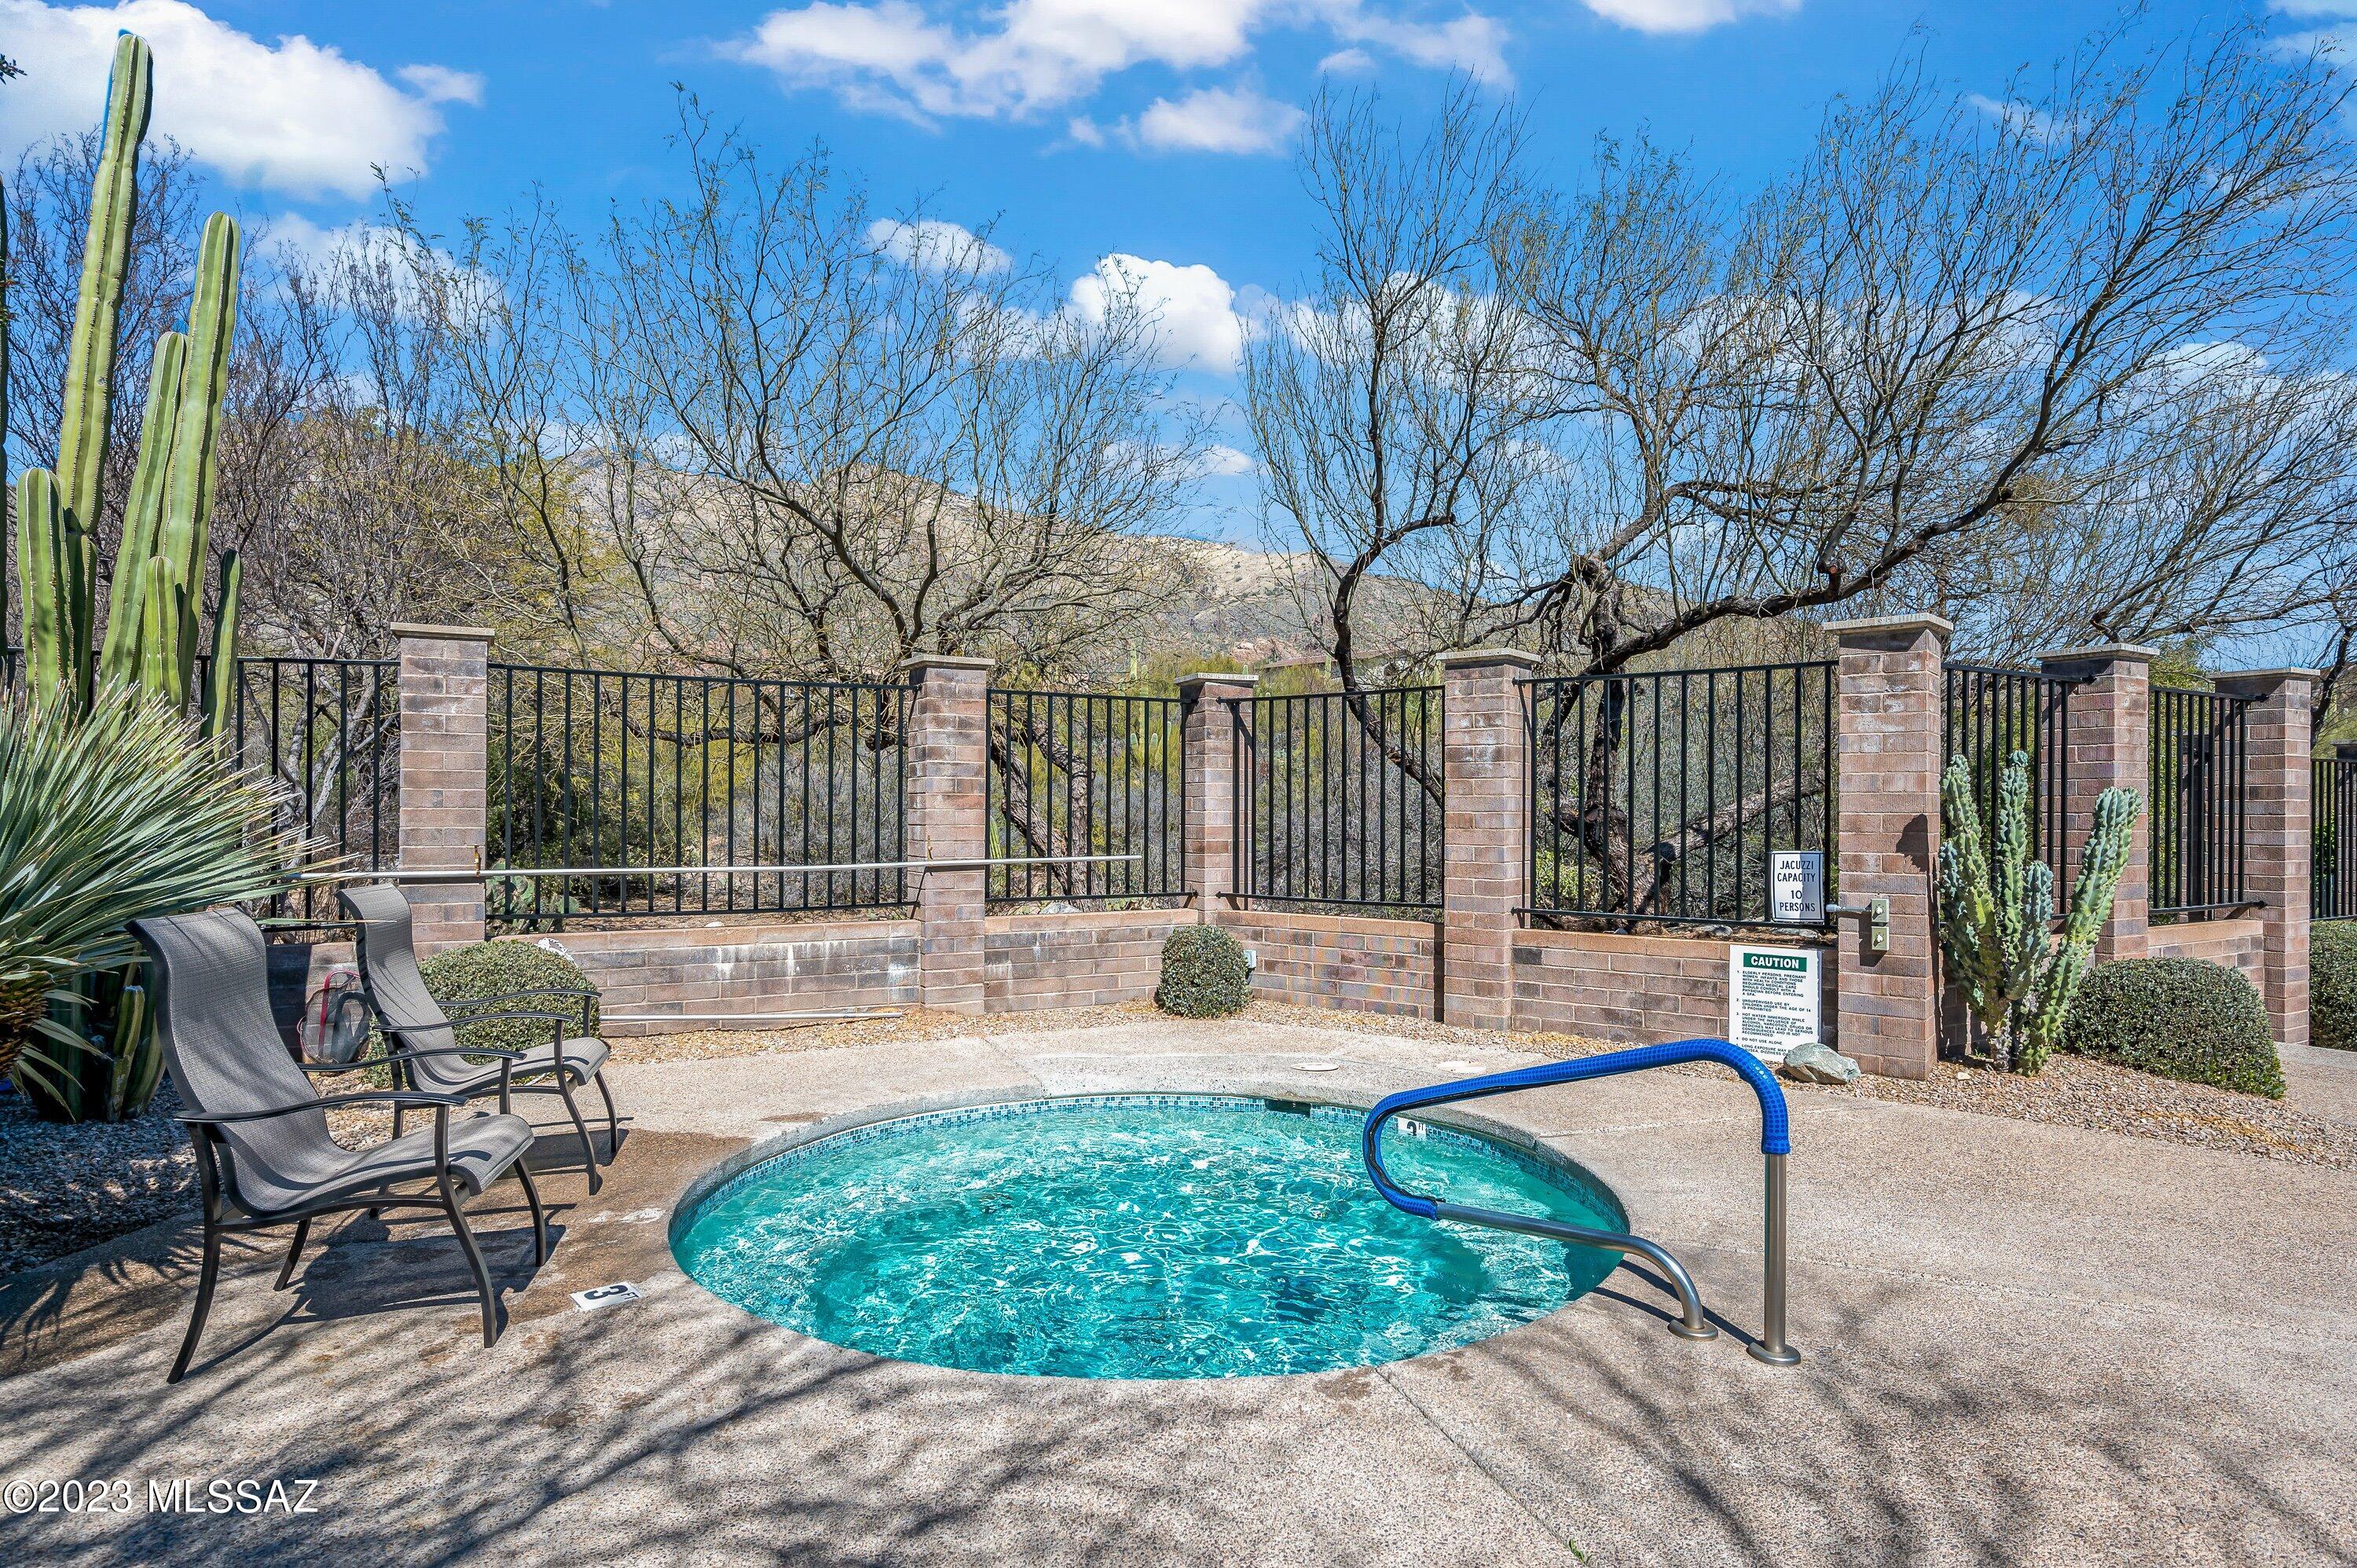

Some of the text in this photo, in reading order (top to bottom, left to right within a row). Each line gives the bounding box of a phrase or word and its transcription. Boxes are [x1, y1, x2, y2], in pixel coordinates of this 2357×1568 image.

[1780, 861, 1814, 870] JACUZZI
[1777, 873, 1816, 882] CAPACITY
[1791, 890, 1802, 899] 10
[1780, 903, 1816, 912] PERSONS
[1750, 956, 1799, 969] CAUTION
[584, 1284, 628, 1300] 3
